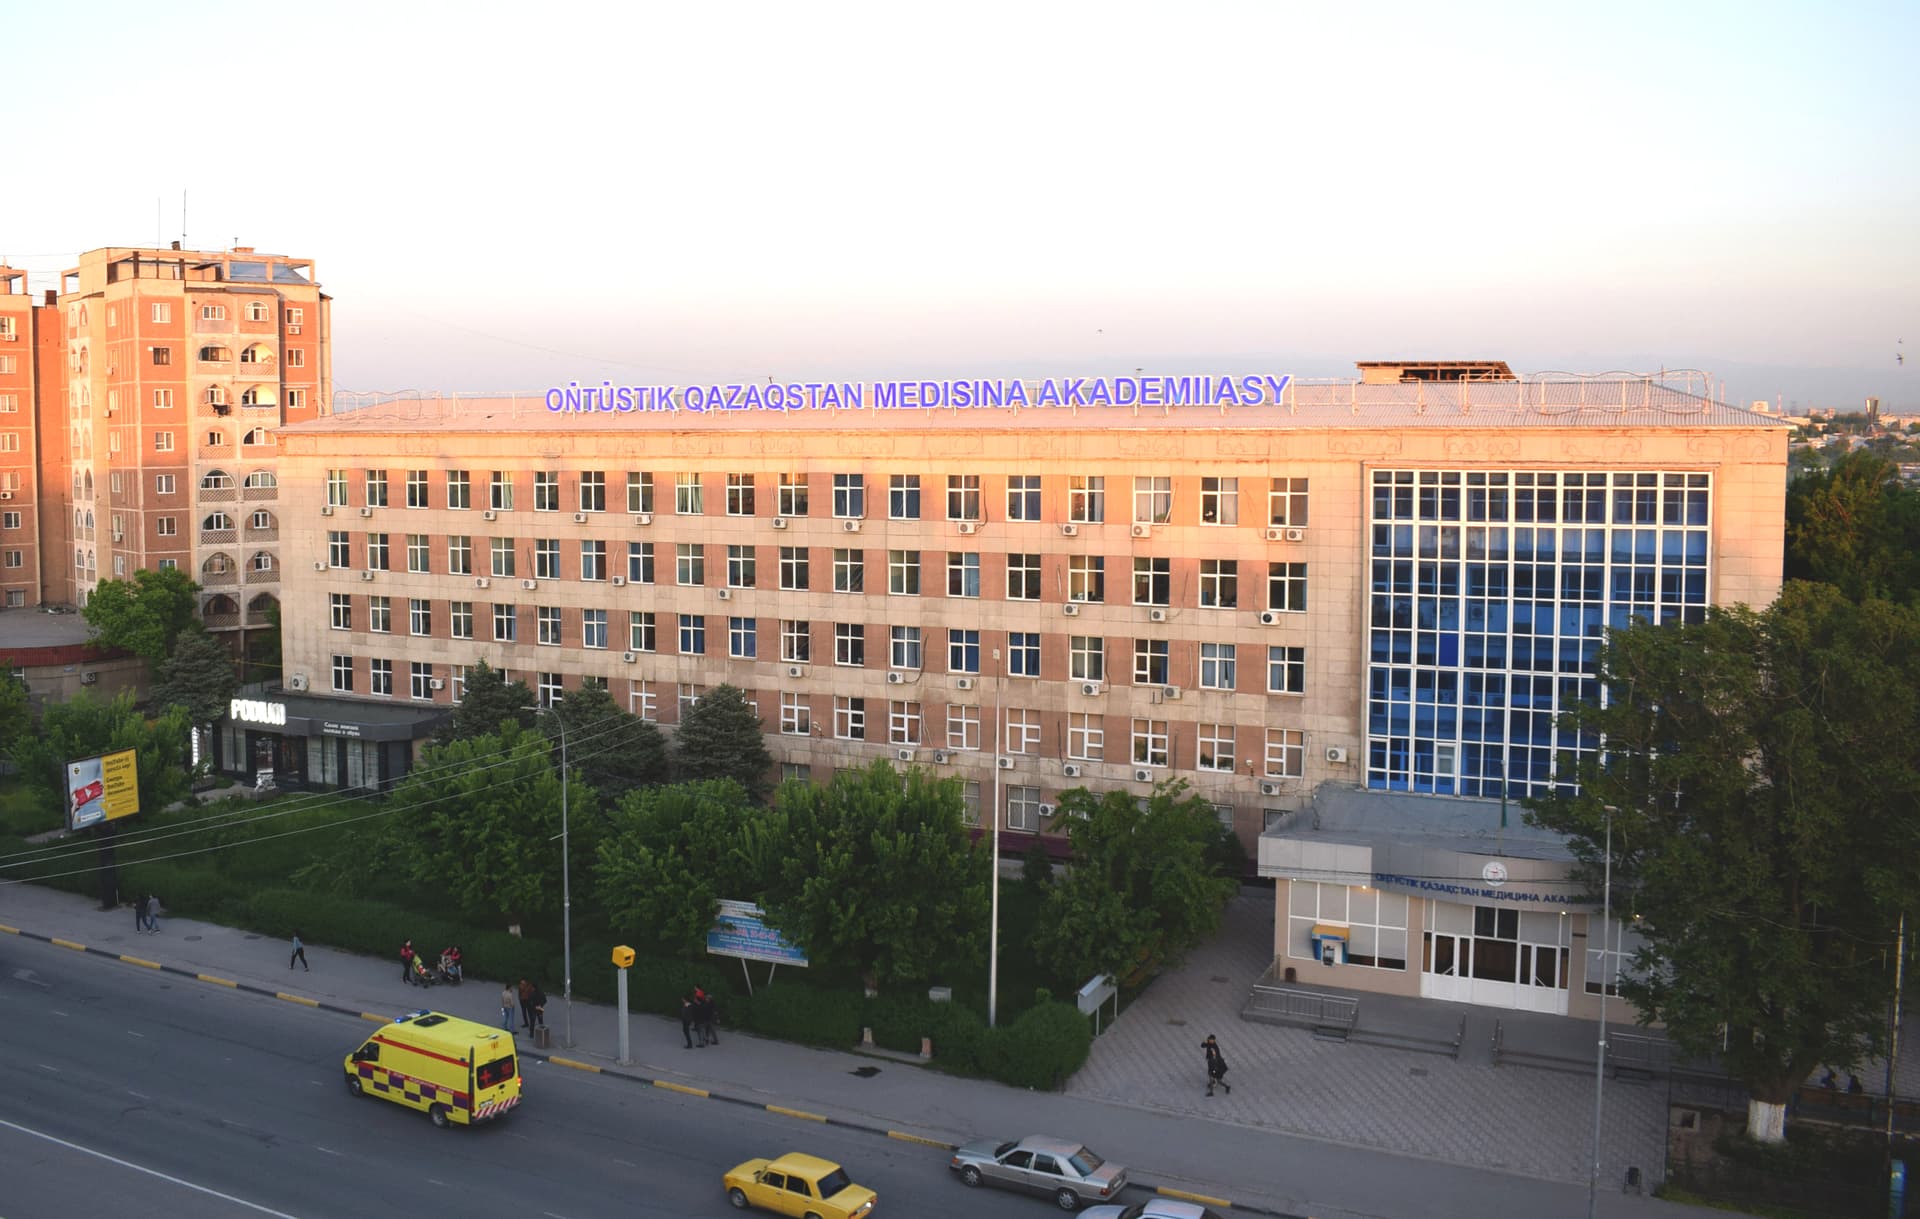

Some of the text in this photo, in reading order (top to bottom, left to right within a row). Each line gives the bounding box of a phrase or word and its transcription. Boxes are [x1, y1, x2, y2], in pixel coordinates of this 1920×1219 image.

[684, 383, 862, 412] QAZAQSTAN
[874, 380, 1029, 408] MEDISINA
[1038, 375, 1291, 406] AKADEMIIASY
[1481, 889, 1540, 902] МЕДИЦИНА
